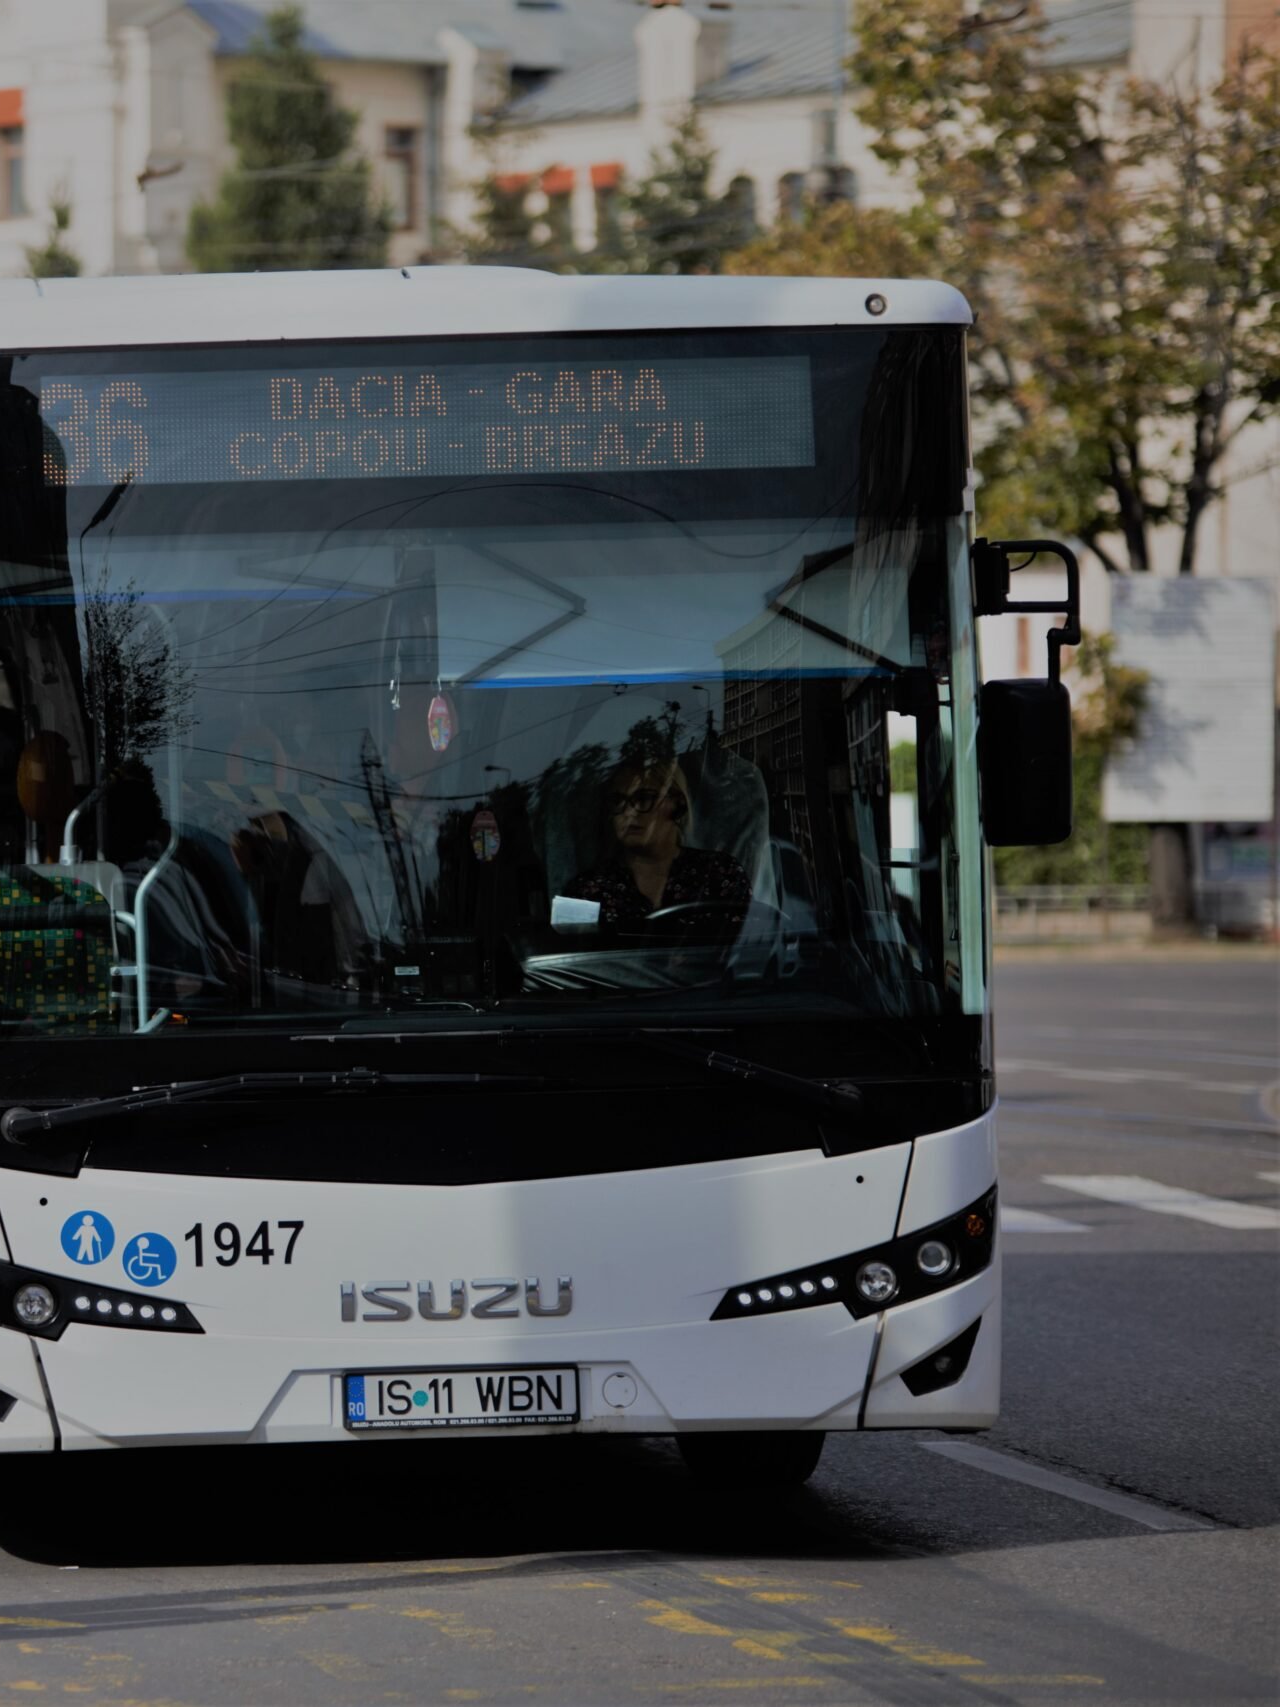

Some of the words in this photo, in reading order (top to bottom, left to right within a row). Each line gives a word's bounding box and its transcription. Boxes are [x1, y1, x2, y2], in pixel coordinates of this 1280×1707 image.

[40, 382, 149, 484] 36
[270, 374, 447, 419] DACIA
[506, 368, 666, 414] GARA
[229, 428, 426, 476] COPOU
[485, 421, 705, 469] BREAZU
[183, 1219, 305, 1268] 1947
[340, 1273, 574, 1323] ISUZU
[348, 1402, 365, 1417] RO
[378, 1379, 412, 1416] IS
[428, 1378, 453, 1414] 11
[475, 1374, 563, 1412] WBN
